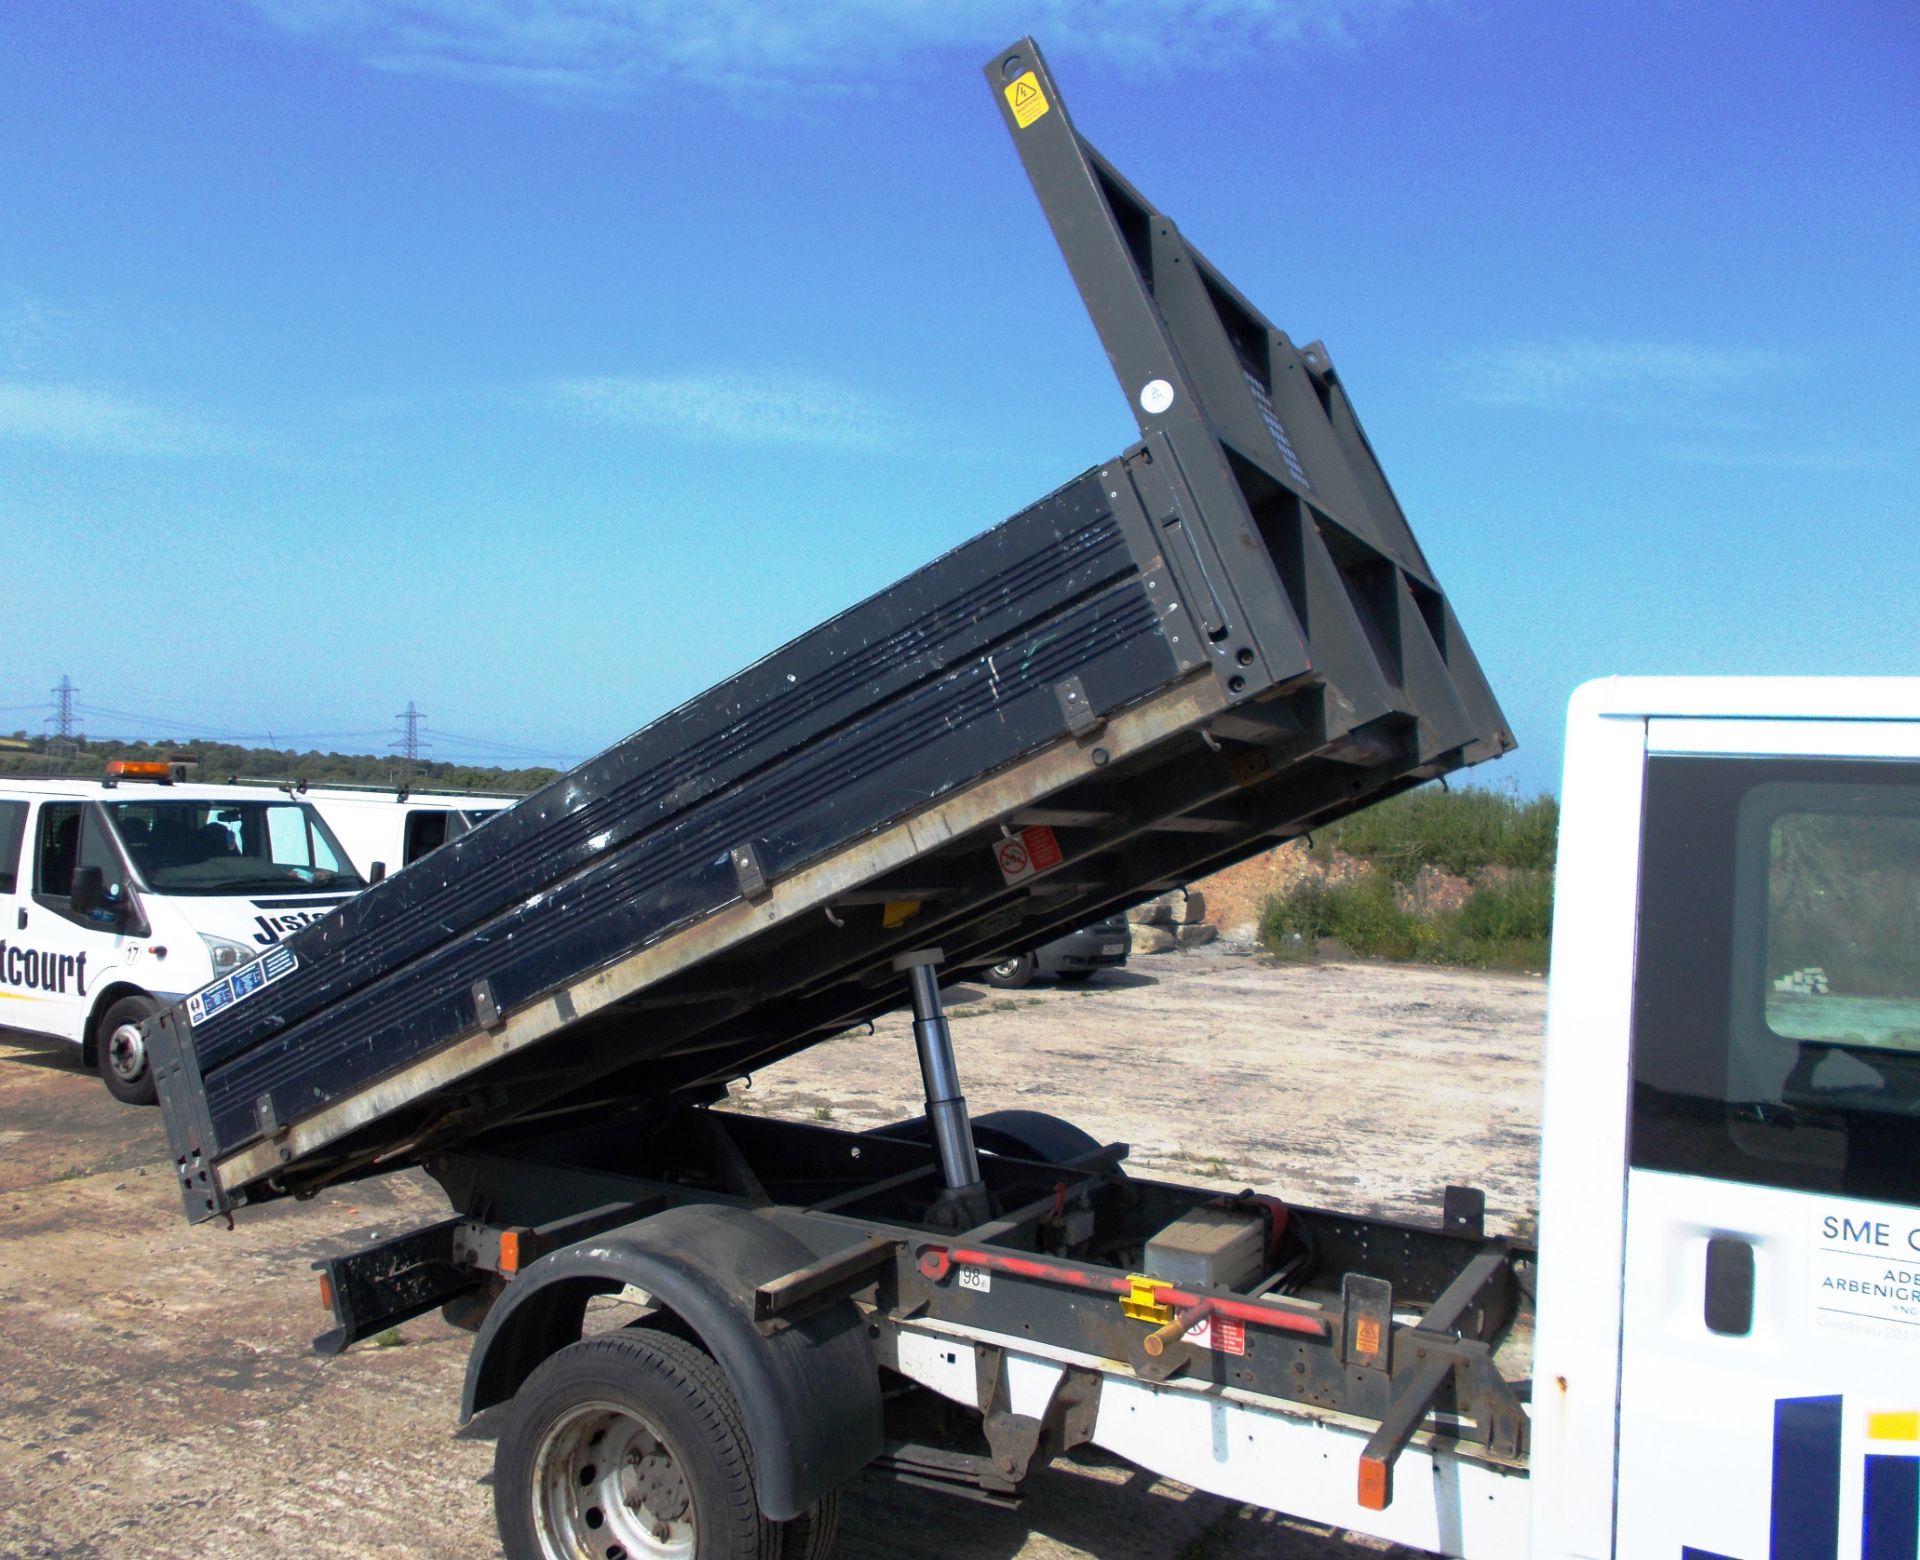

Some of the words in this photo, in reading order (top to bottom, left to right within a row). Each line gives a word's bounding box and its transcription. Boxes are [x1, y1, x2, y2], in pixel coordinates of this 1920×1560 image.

[127, 946, 139, 959] 17
[1823, 1216, 1890, 1246] SME
[964, 1266, 980, 1286] 98
[1822, 1277, 1920, 1302] ARBENIGR
